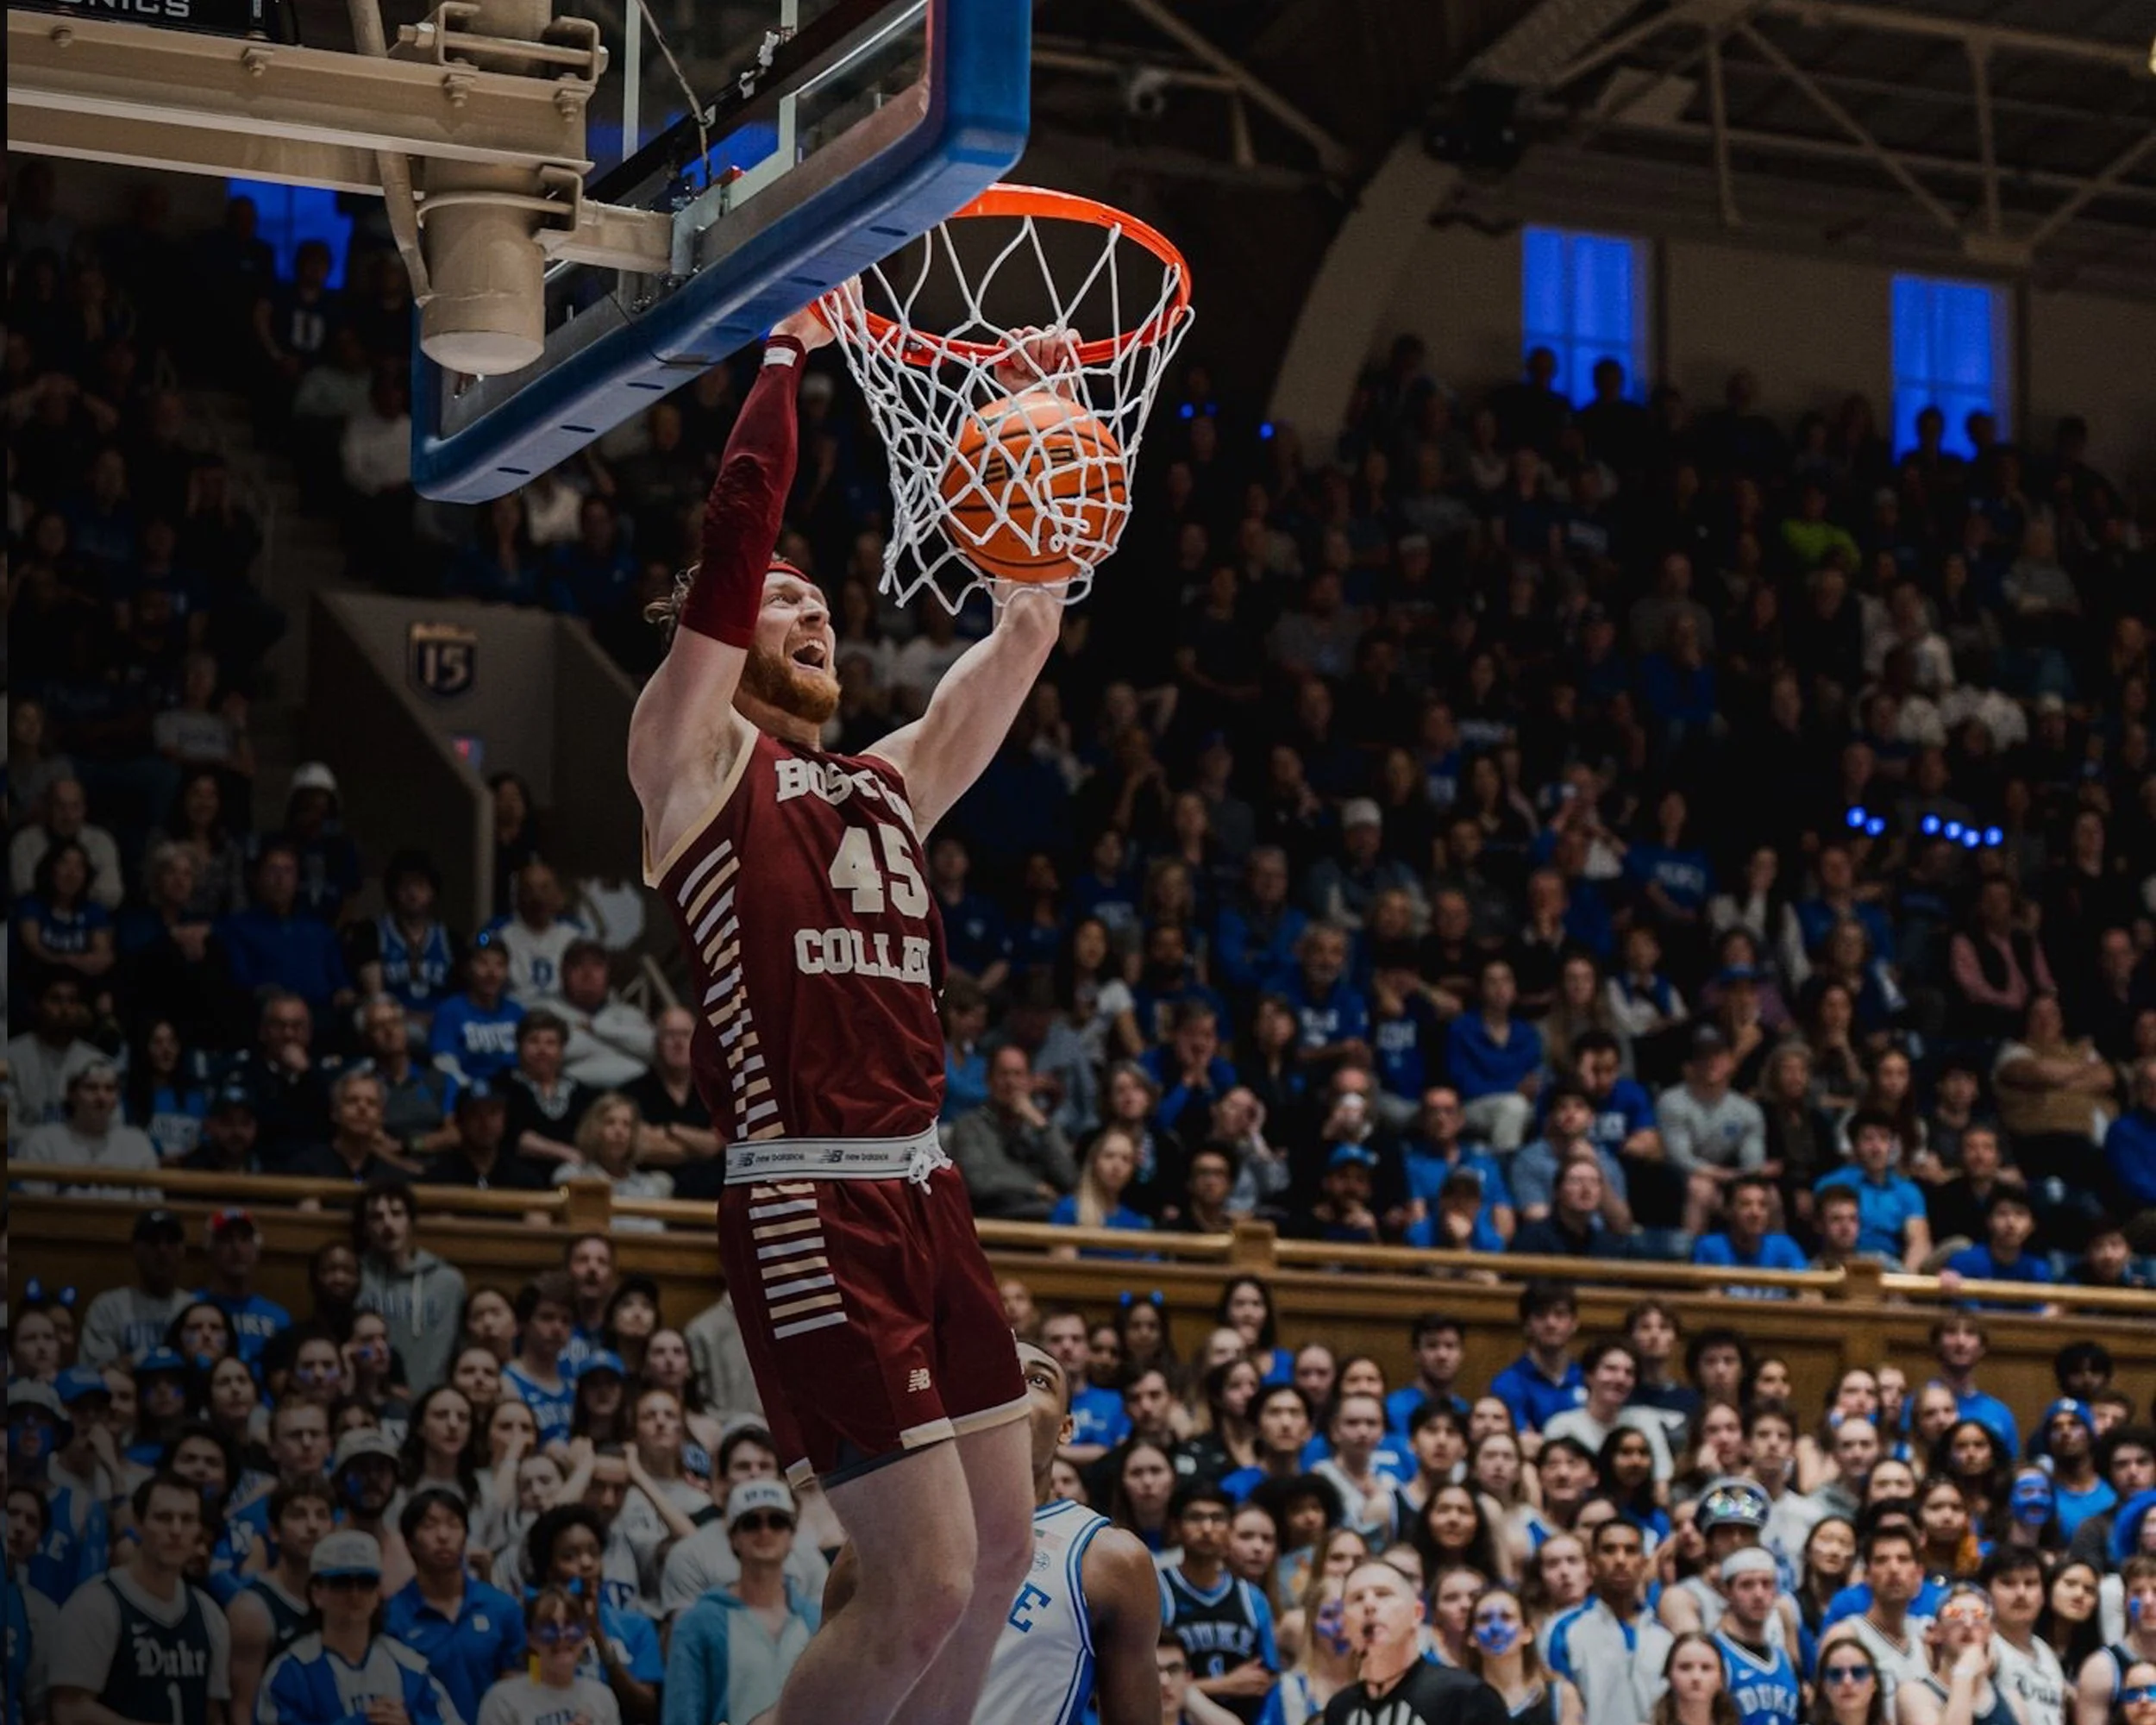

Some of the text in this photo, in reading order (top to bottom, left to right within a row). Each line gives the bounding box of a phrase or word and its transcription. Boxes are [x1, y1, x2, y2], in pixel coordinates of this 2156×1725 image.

[424, 644, 467, 688] 15
[828, 823, 931, 919] 45
[794, 926, 931, 990] COLLE
